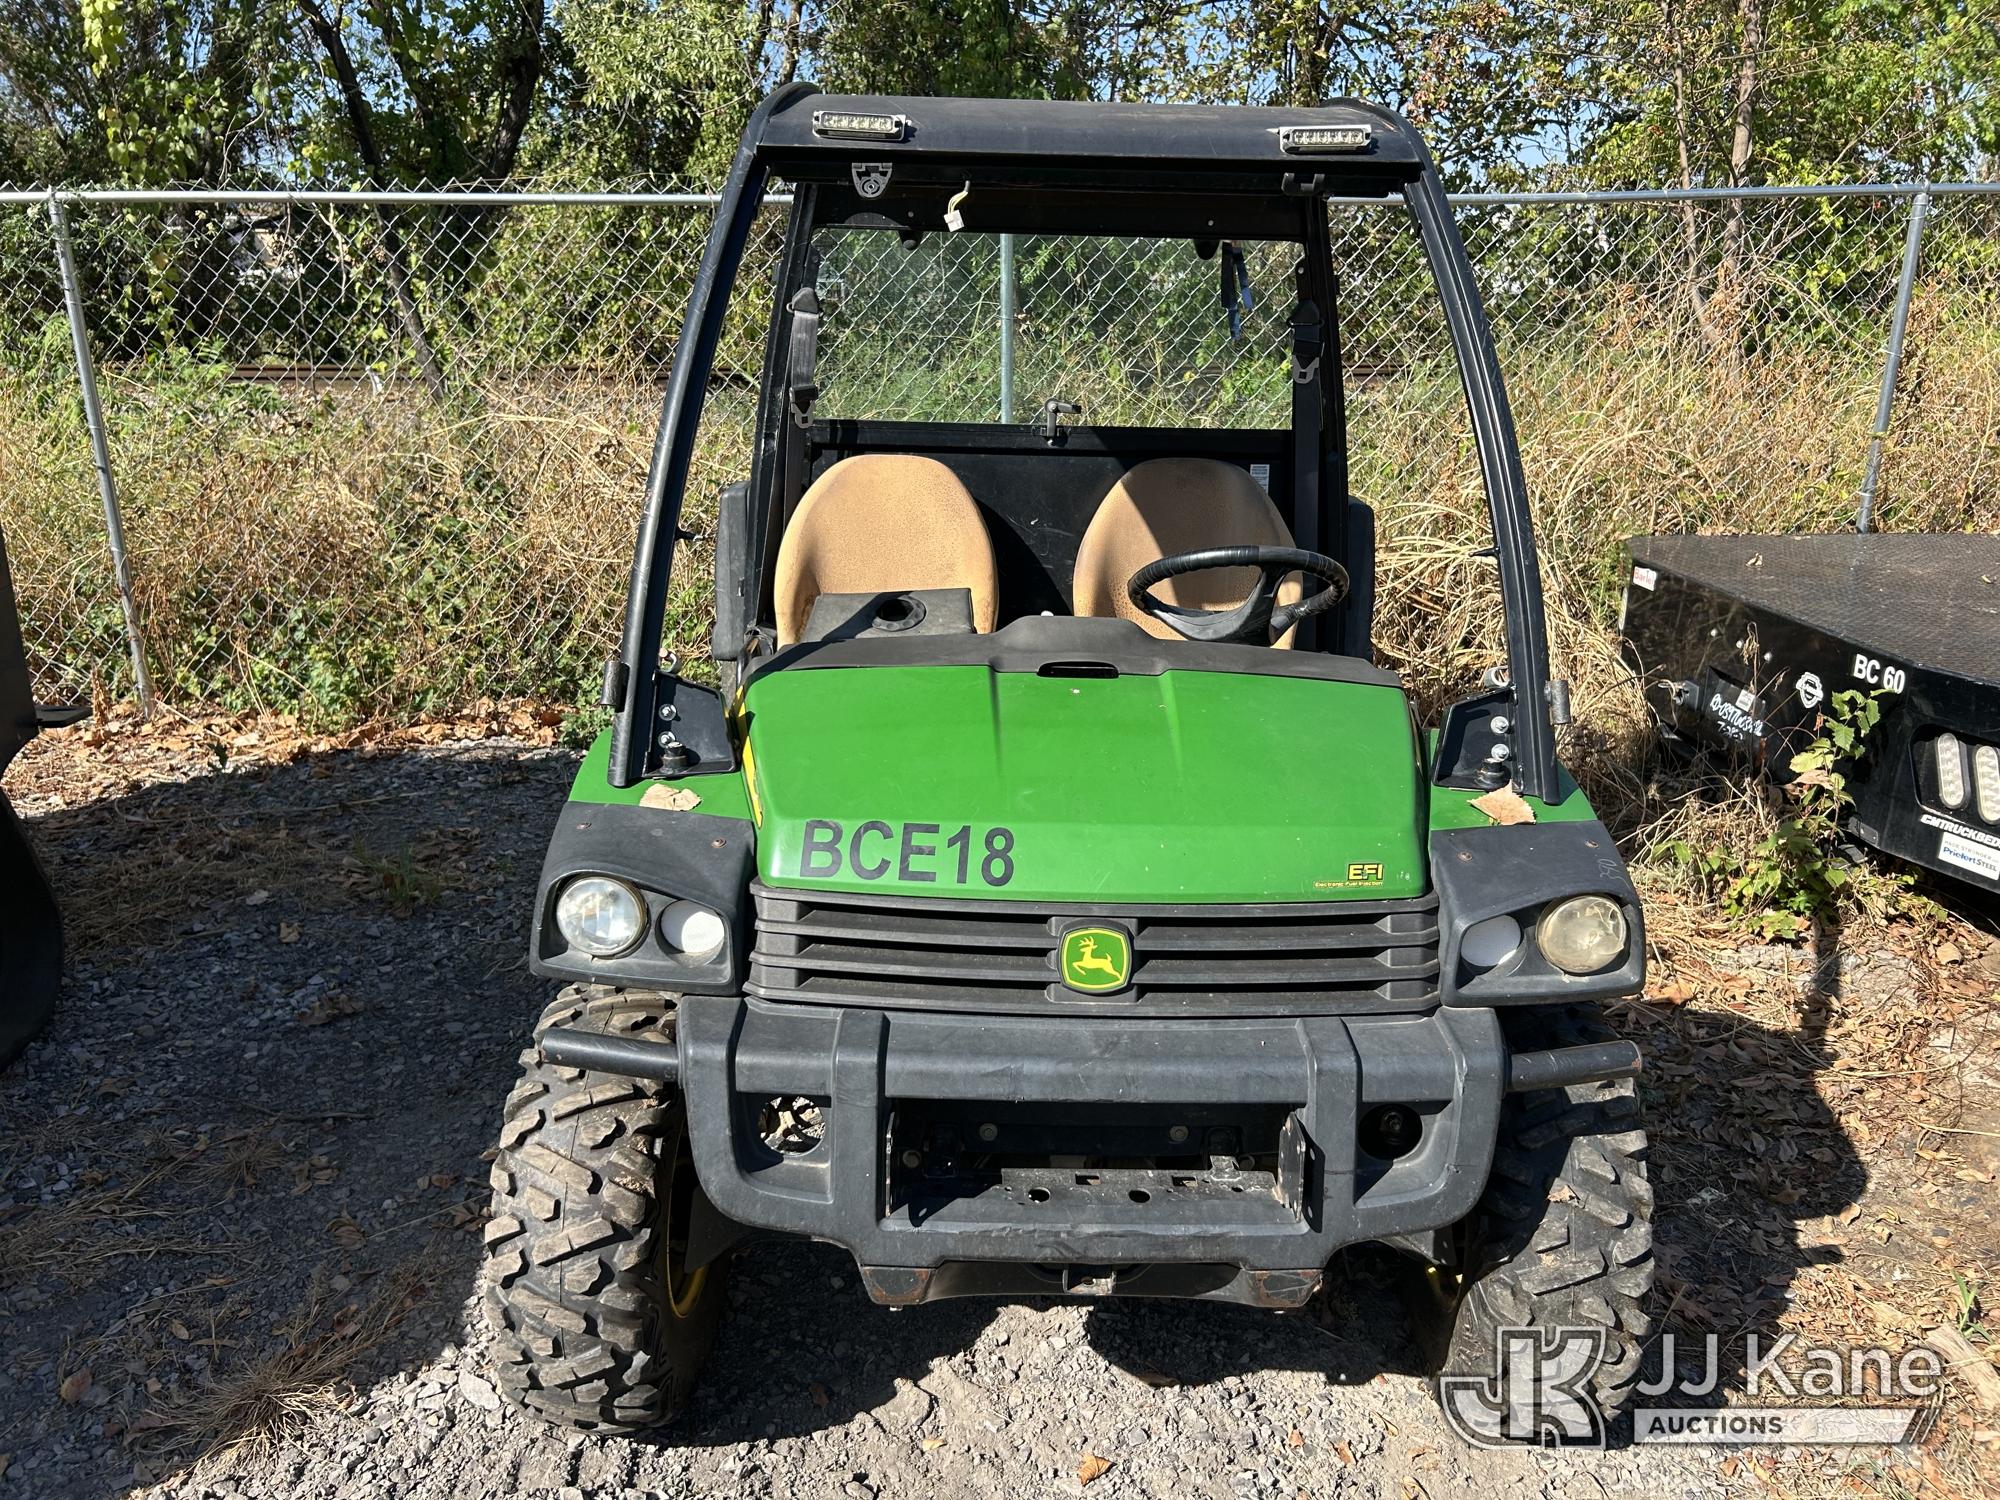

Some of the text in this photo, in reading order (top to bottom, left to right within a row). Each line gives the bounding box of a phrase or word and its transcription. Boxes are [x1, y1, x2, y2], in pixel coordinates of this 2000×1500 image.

[1853, 653, 1905, 694] BC 60
[1920, 814, 2000, 849] CMTRUCKBED
[800, 819, 1014, 887] BCE18
[1348, 863, 1384, 880] EFI
